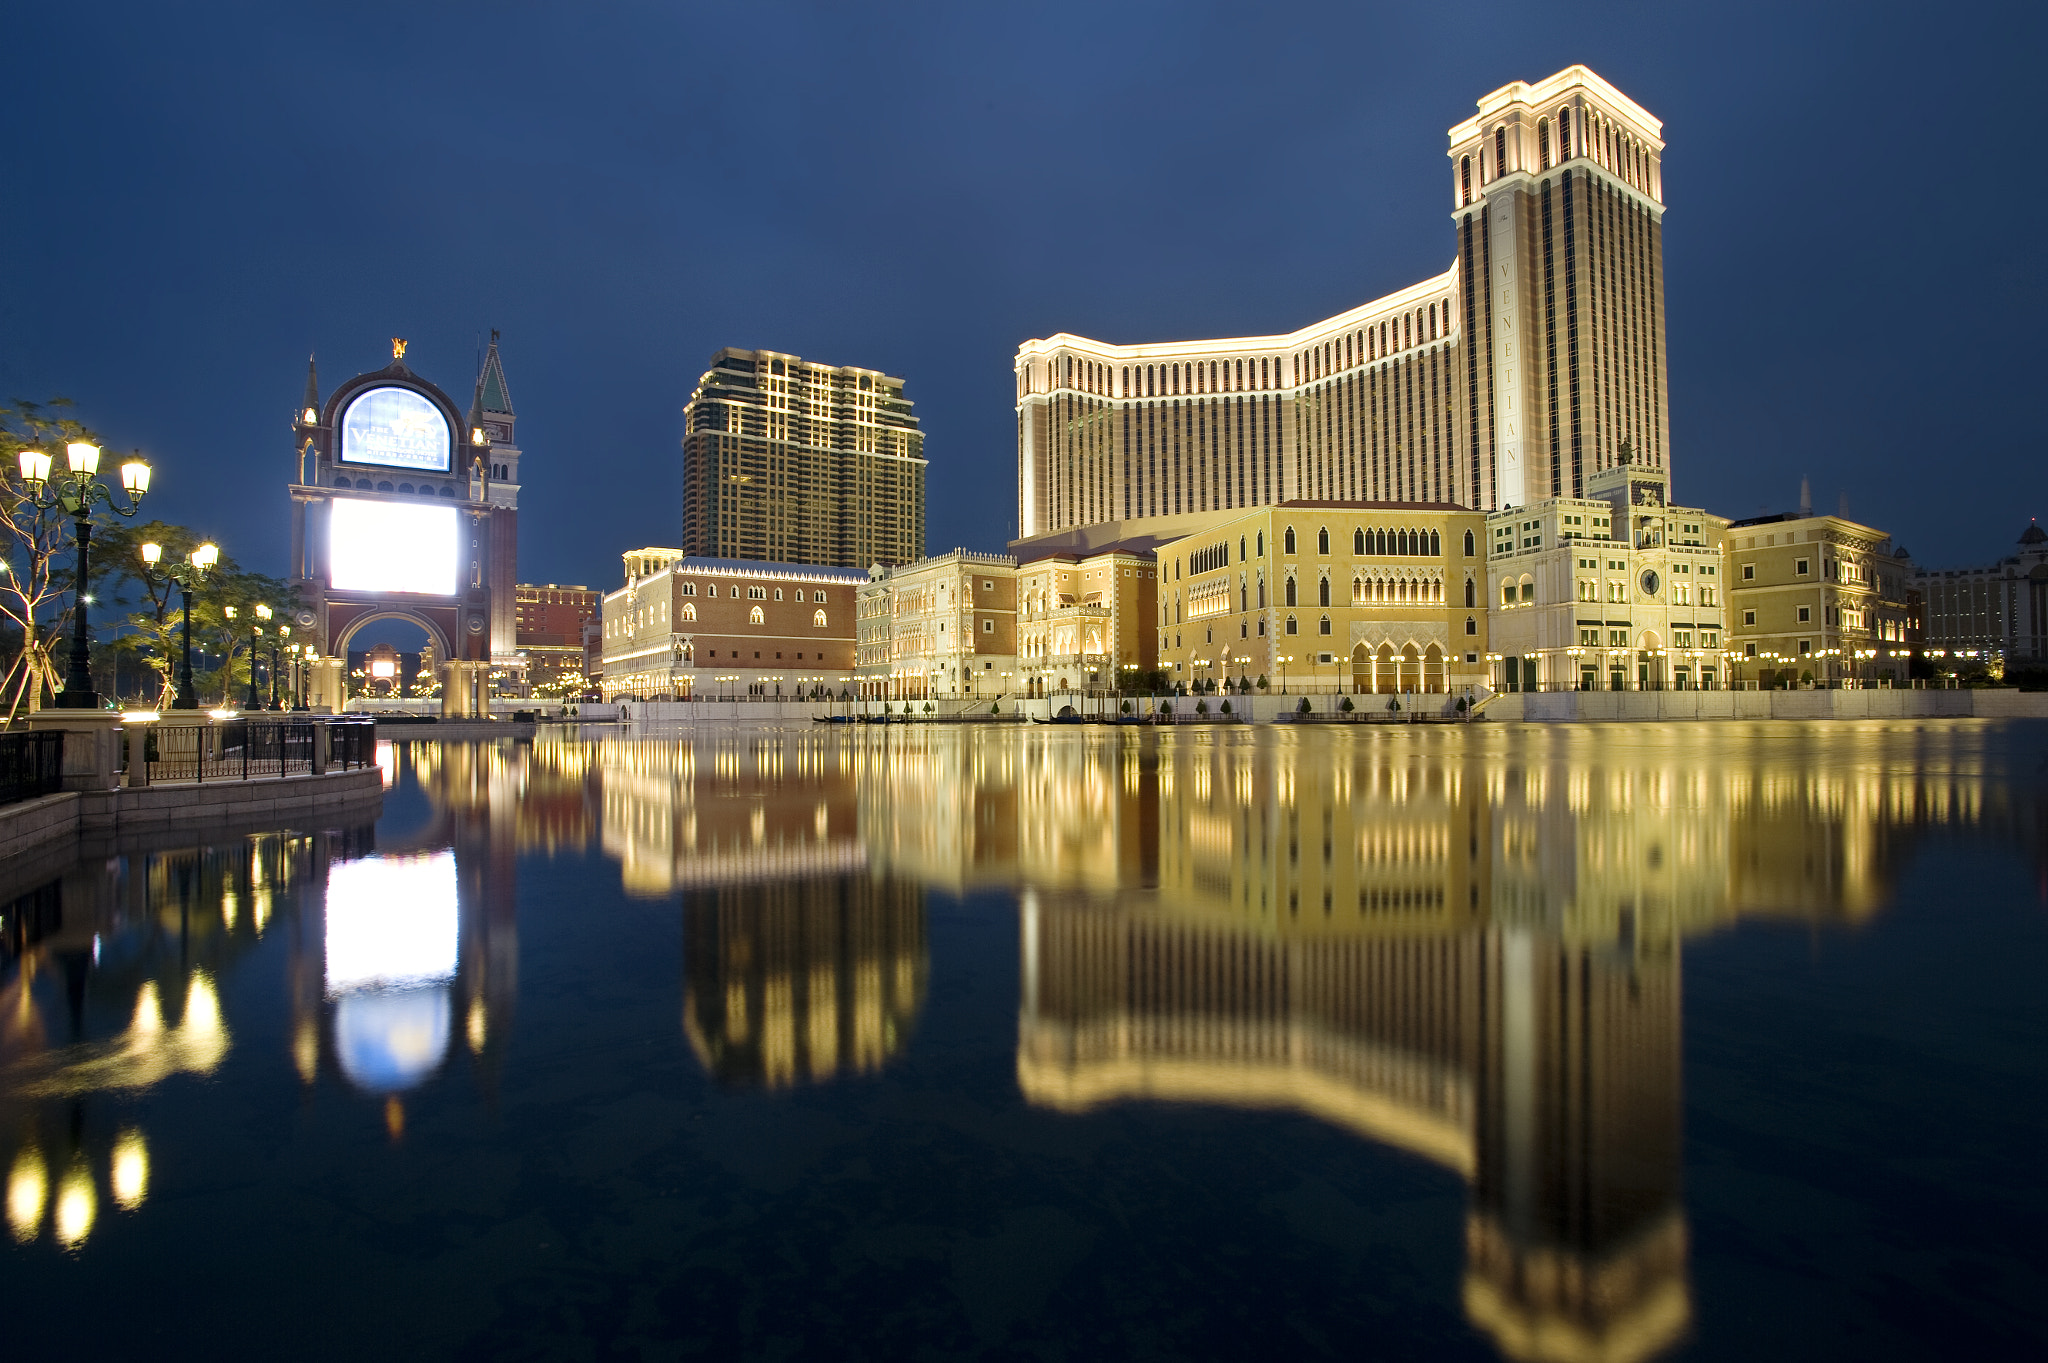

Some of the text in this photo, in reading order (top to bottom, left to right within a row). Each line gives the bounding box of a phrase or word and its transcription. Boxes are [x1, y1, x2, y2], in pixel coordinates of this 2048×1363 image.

[1501, 263, 1516, 465] VENETIAN
[351, 427, 438, 450] VENETIAN
[371, 426, 389, 434] THE
